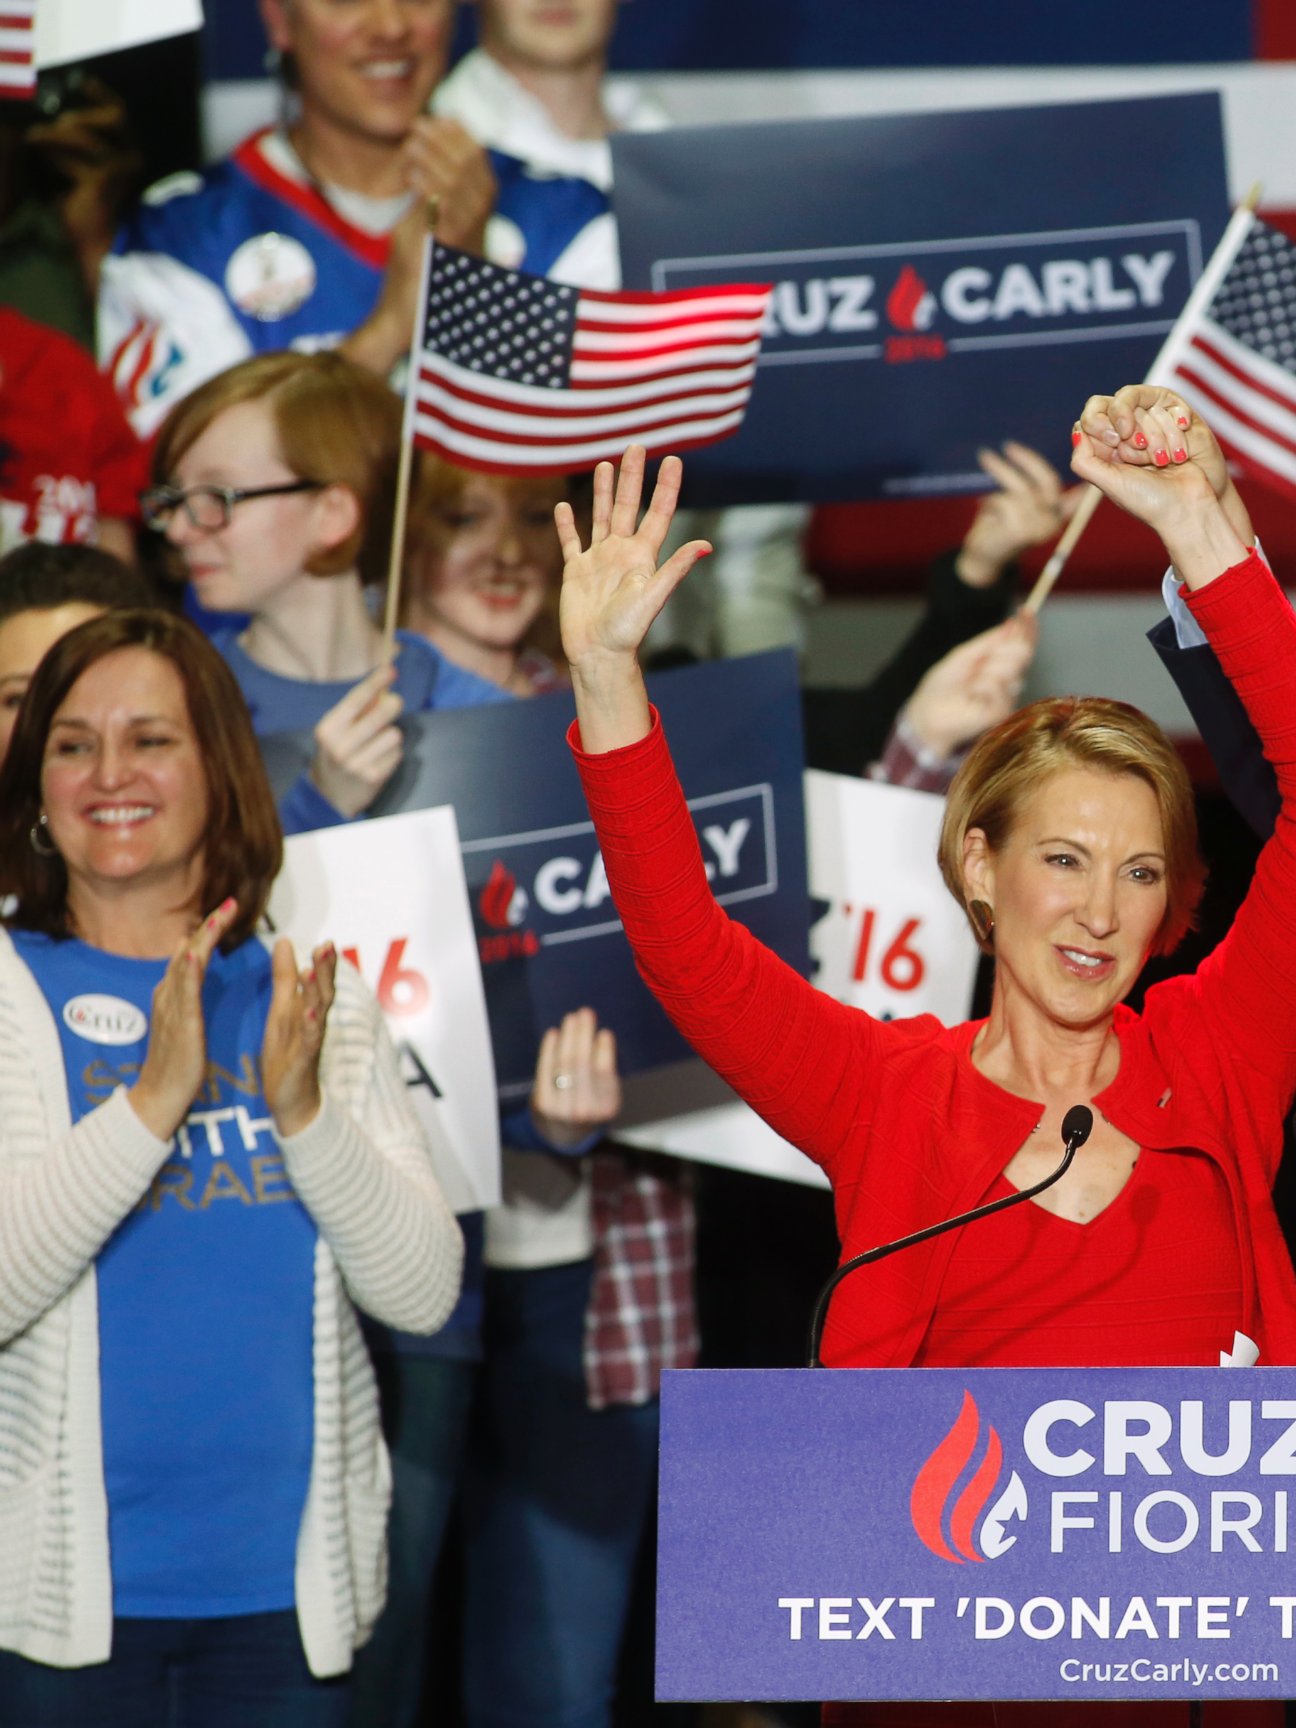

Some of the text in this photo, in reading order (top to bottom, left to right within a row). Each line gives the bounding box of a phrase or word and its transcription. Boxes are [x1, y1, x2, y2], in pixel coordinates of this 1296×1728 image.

[941, 251, 1176, 324] CARLY
[777, 1597, 936, 1641] TEXT
[955, 1595, 1250, 1641] 'DONATE'
[1058, 1658, 1280, 1686] CruzCarly.com
